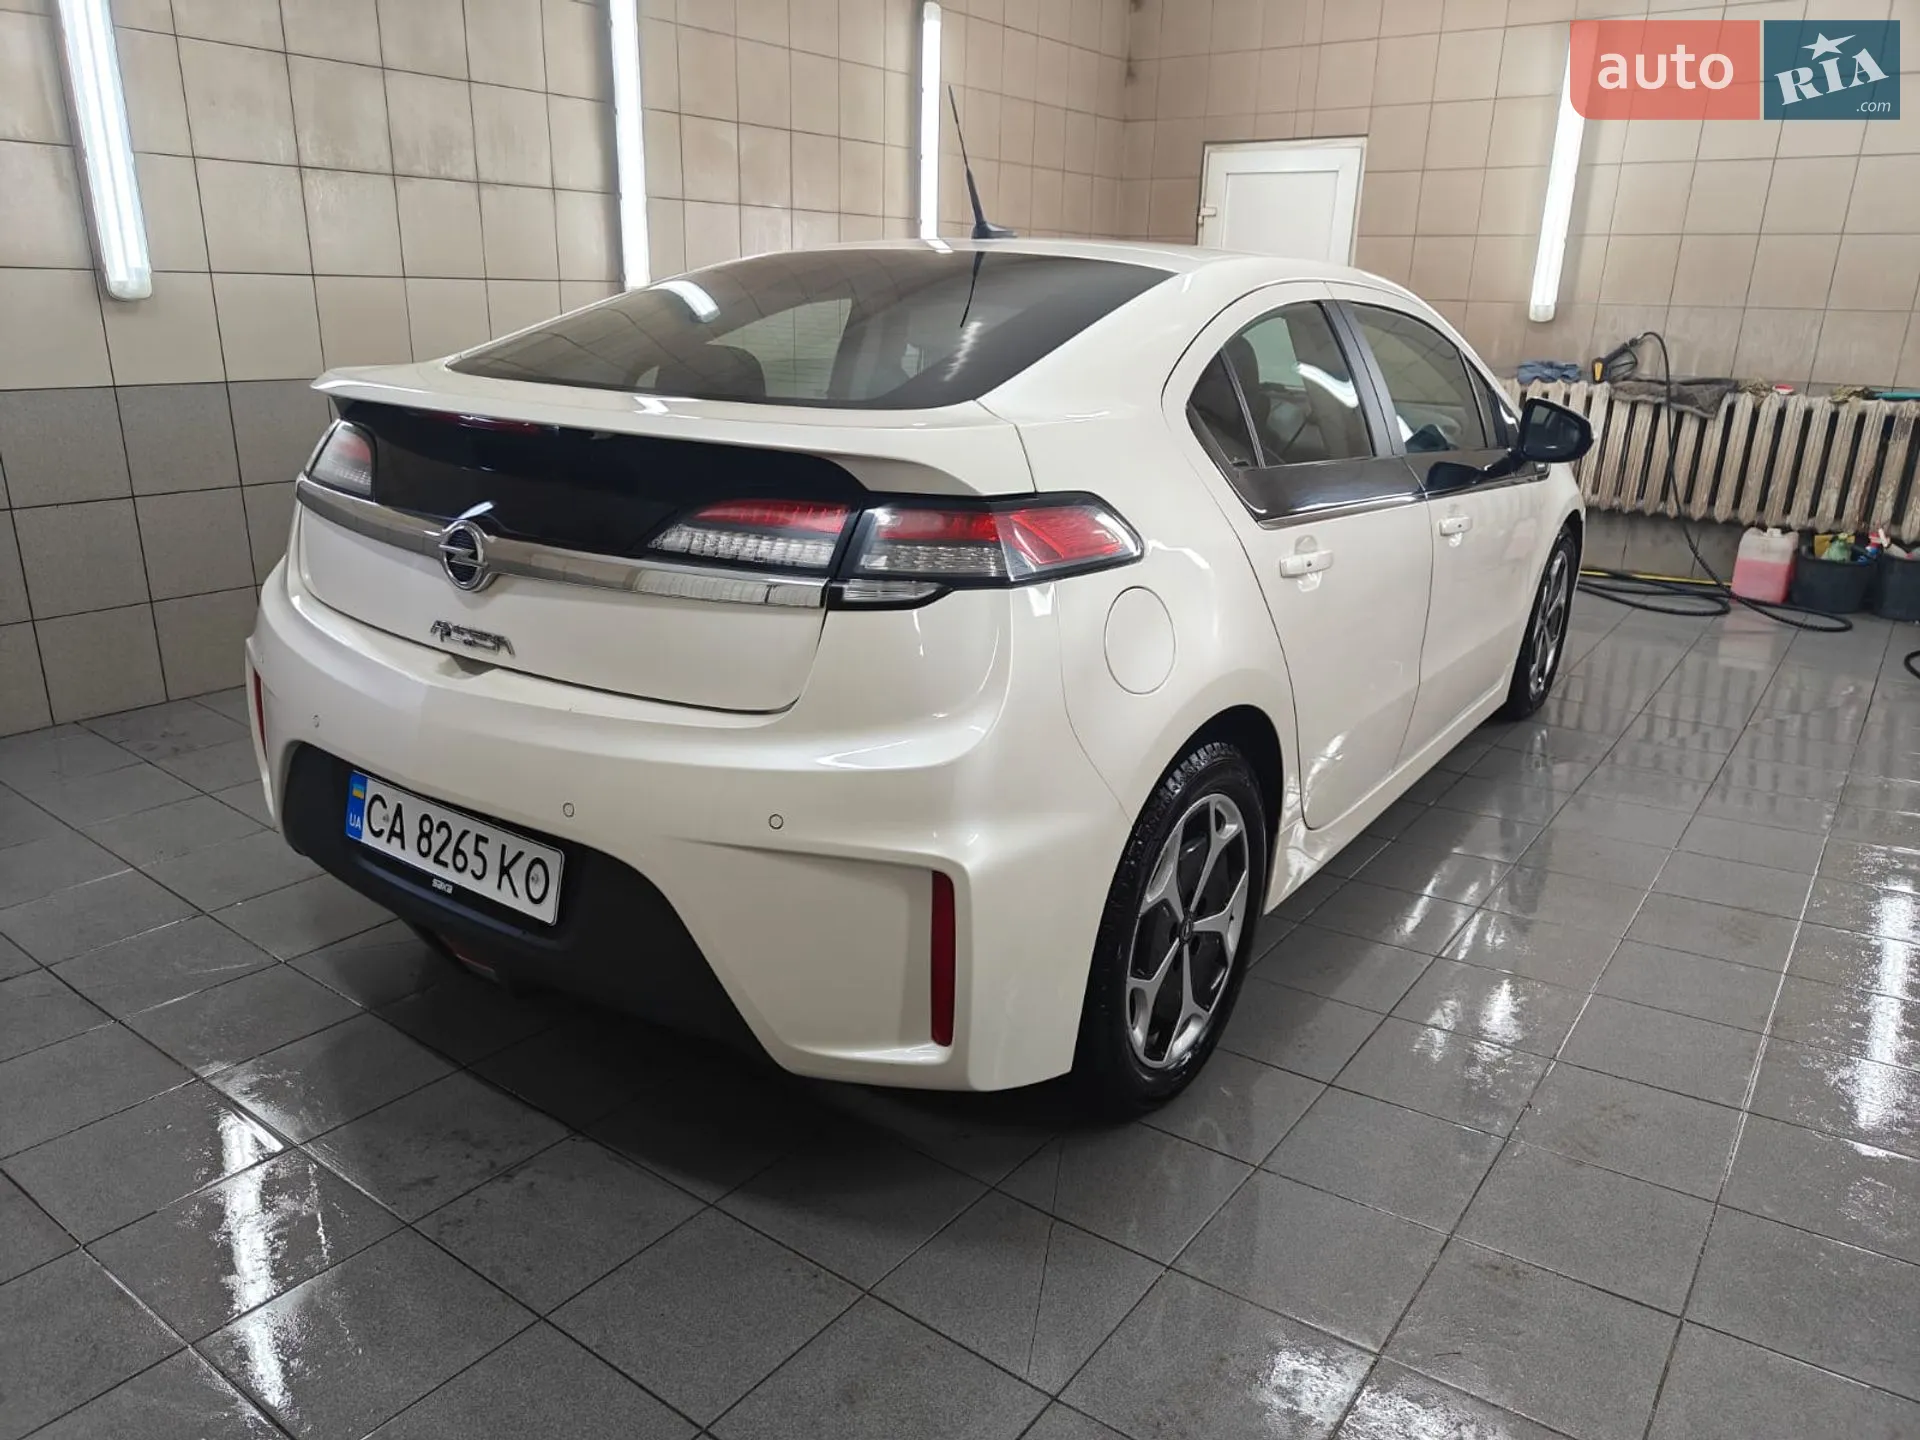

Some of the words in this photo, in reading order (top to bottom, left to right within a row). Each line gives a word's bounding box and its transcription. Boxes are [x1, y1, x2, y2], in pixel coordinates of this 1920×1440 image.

[349, 813, 362, 829] UA
[367, 793, 406, 850] CA
[416, 813, 489, 881] 8265
[496, 843, 550, 904] KO
